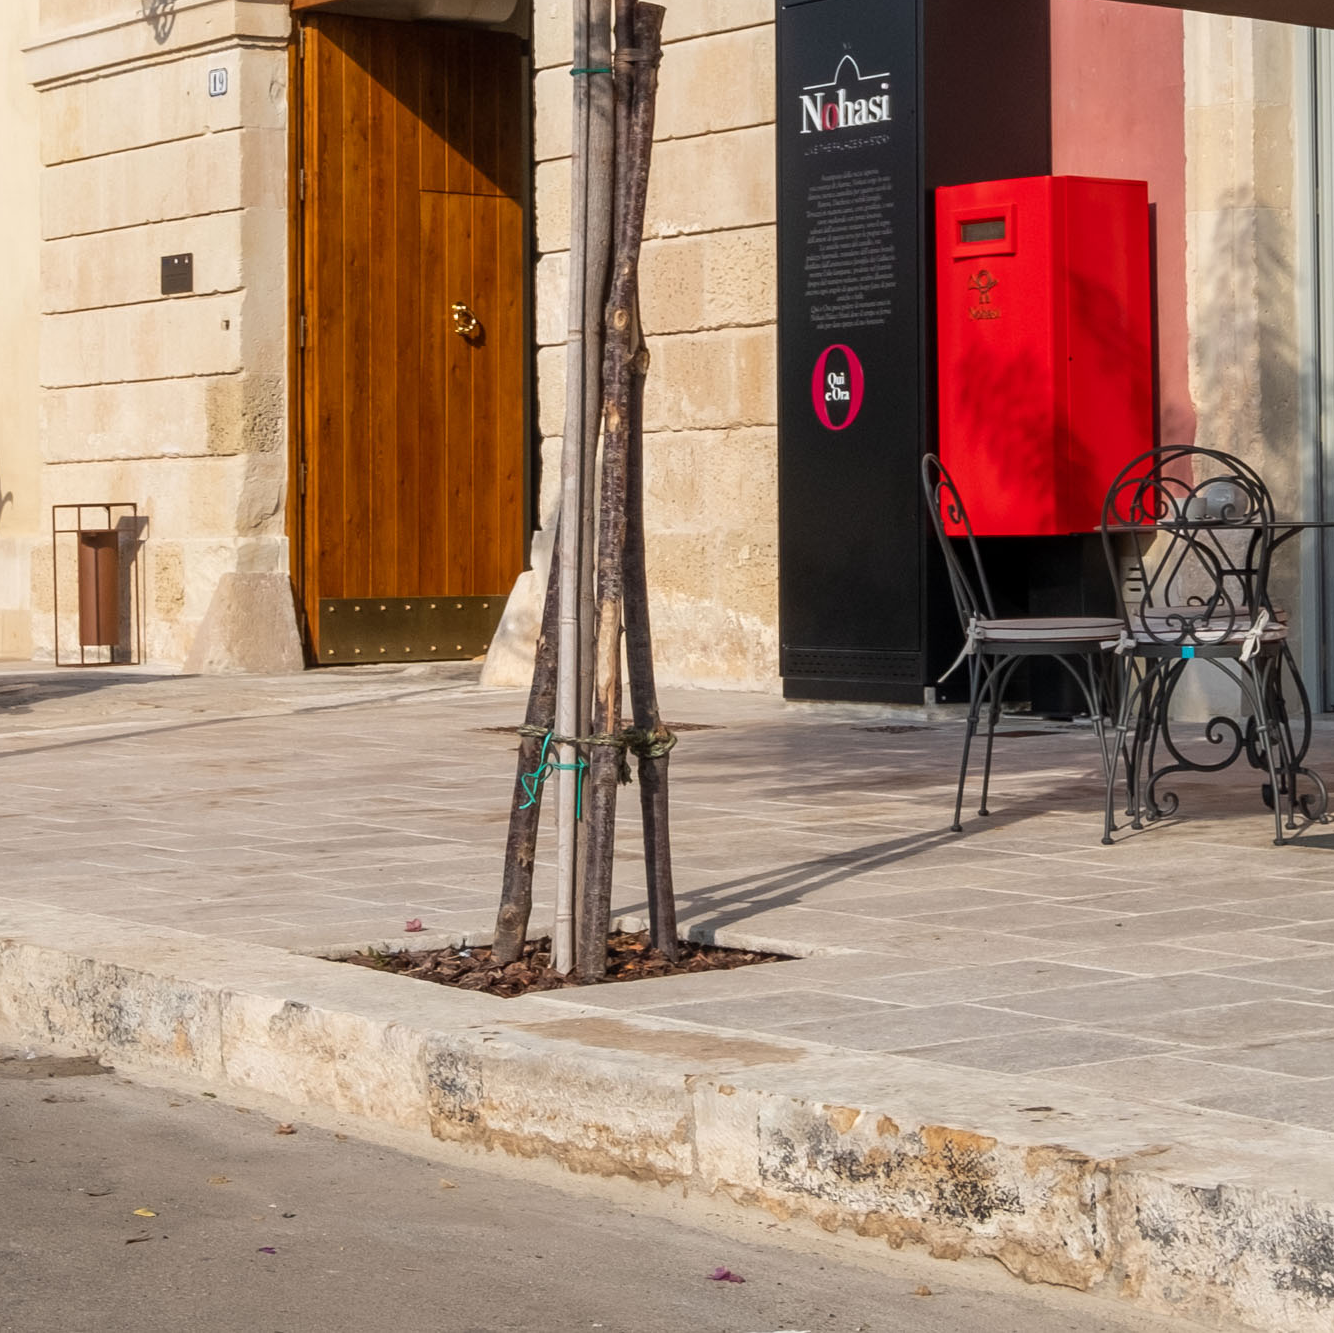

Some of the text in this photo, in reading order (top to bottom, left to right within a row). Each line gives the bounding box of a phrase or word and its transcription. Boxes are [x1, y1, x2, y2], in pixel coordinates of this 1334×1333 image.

[798, 82, 892, 134] Nohasi
[827, 372, 845, 389] Qui
[825, 387, 850, 402] e Ora
